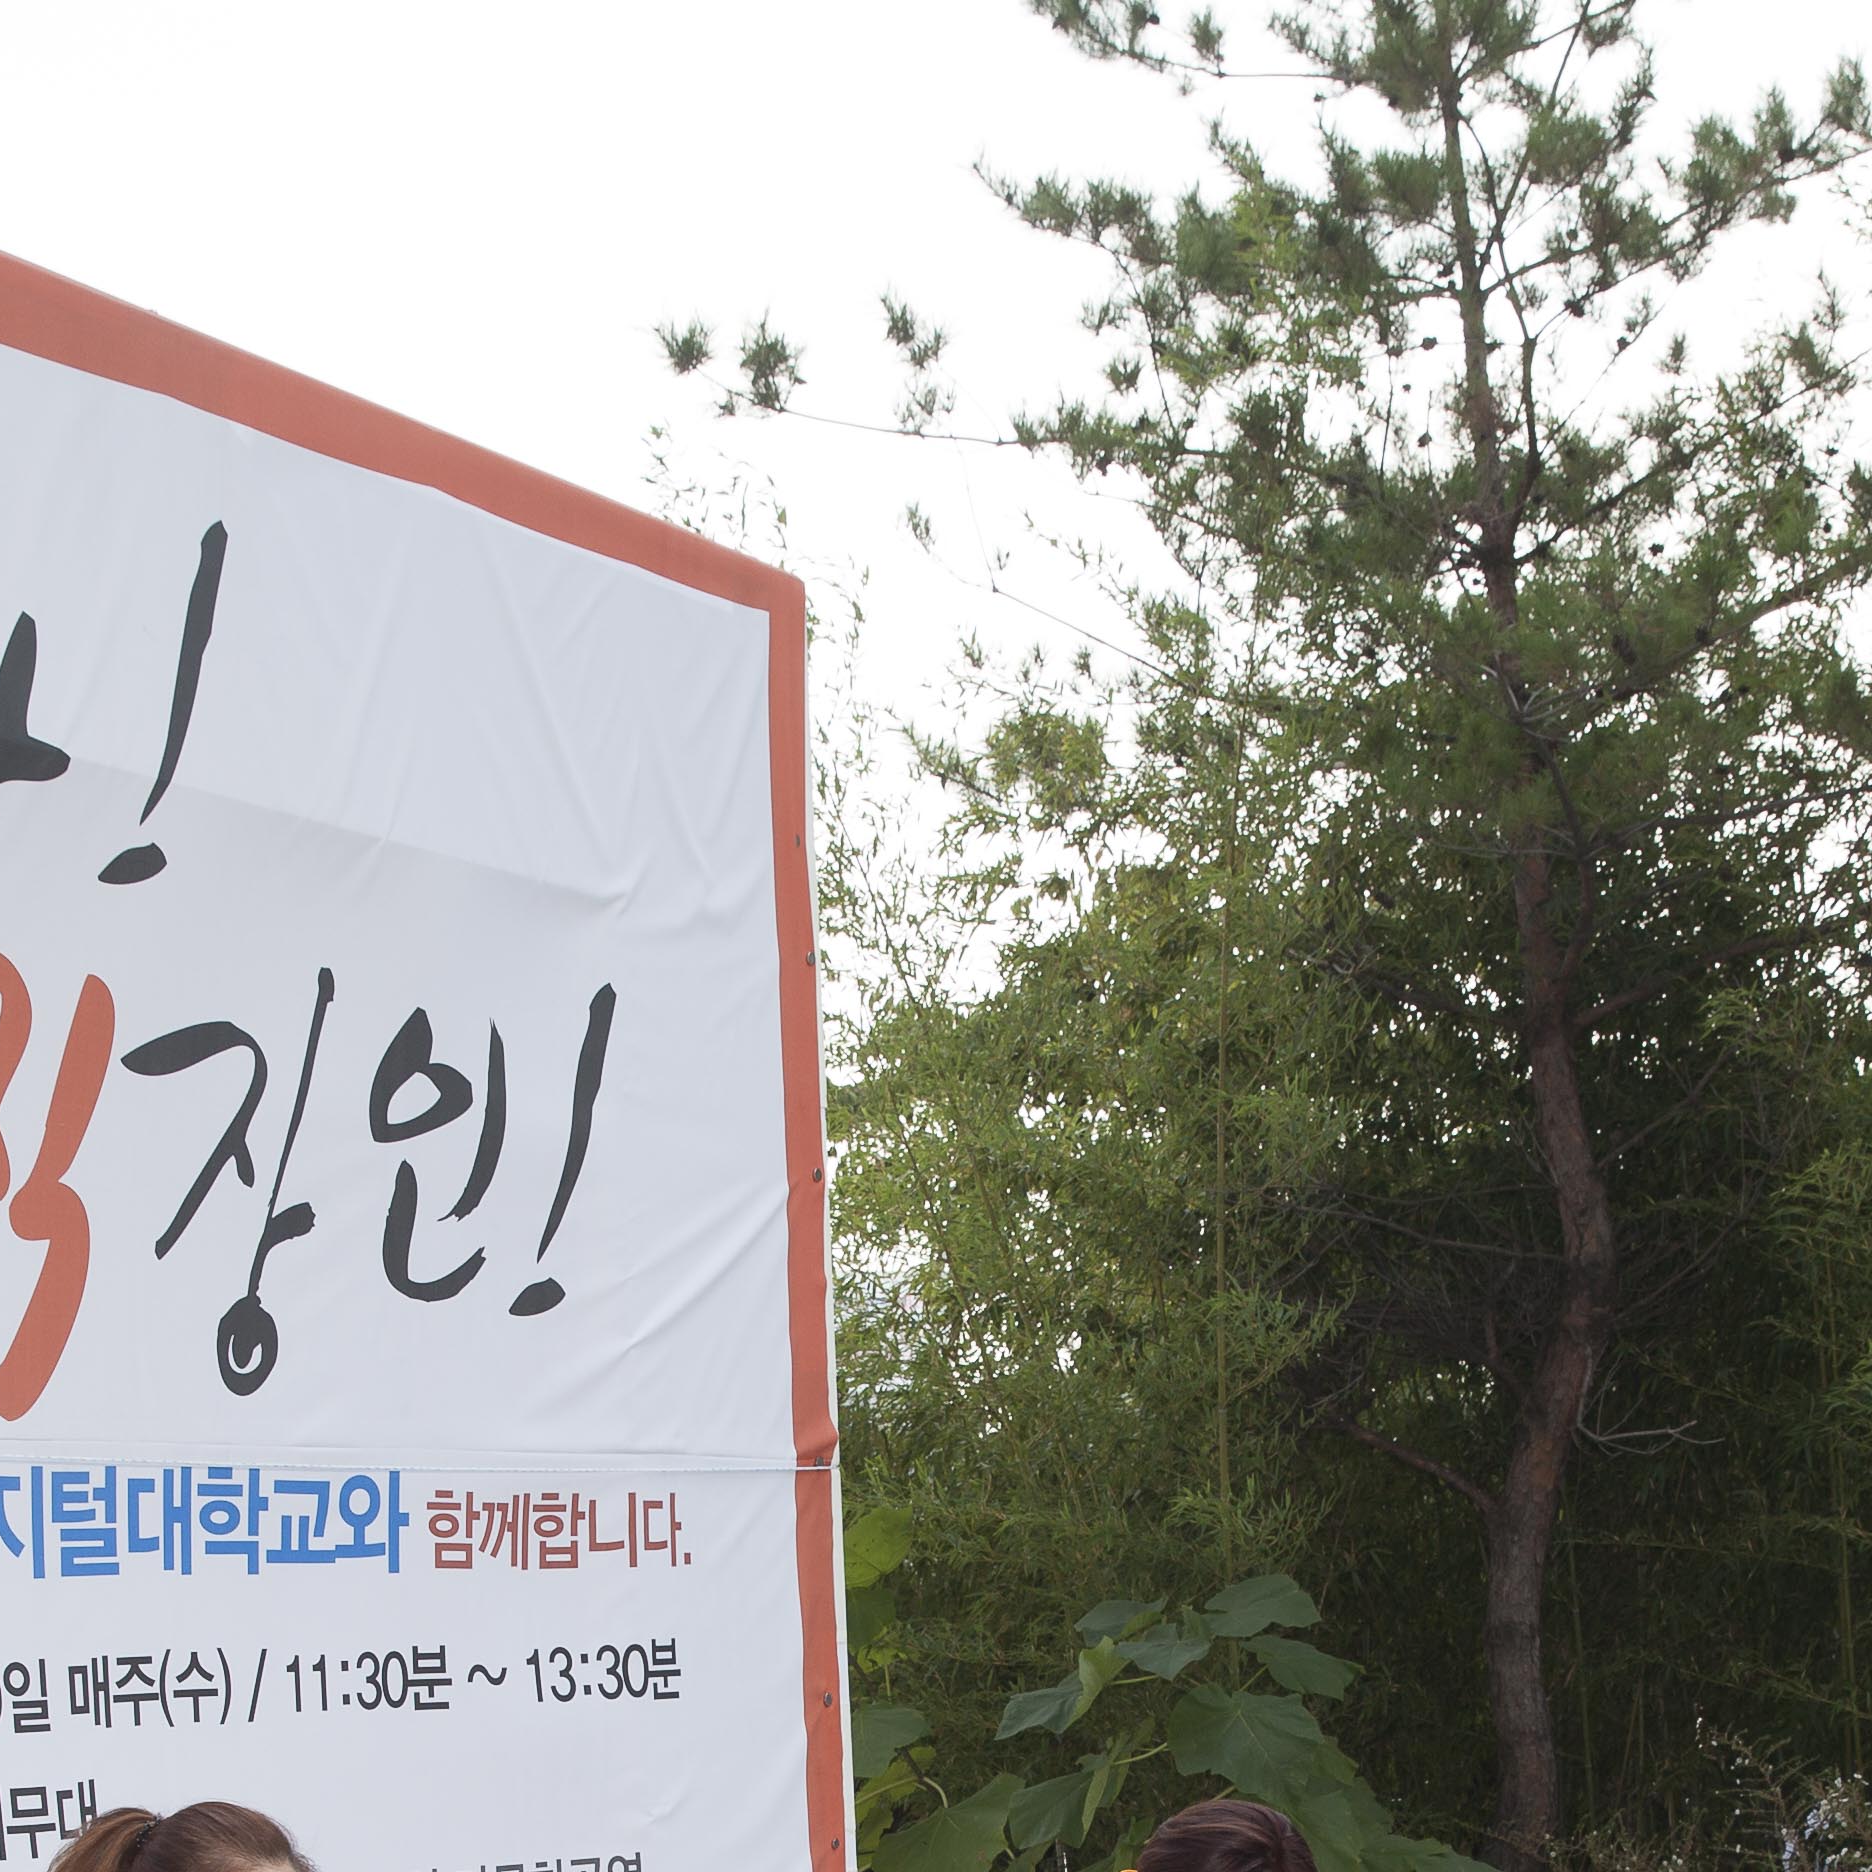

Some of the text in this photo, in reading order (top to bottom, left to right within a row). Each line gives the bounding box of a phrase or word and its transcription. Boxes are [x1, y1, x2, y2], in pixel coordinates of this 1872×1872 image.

[425, 1487, 694, 1571] 함께합니다.
[67, 1648, 233, 1729] 매주(수)
[285, 1644, 453, 1714] 11:30분
[526, 1637, 682, 1705] 13:30분
